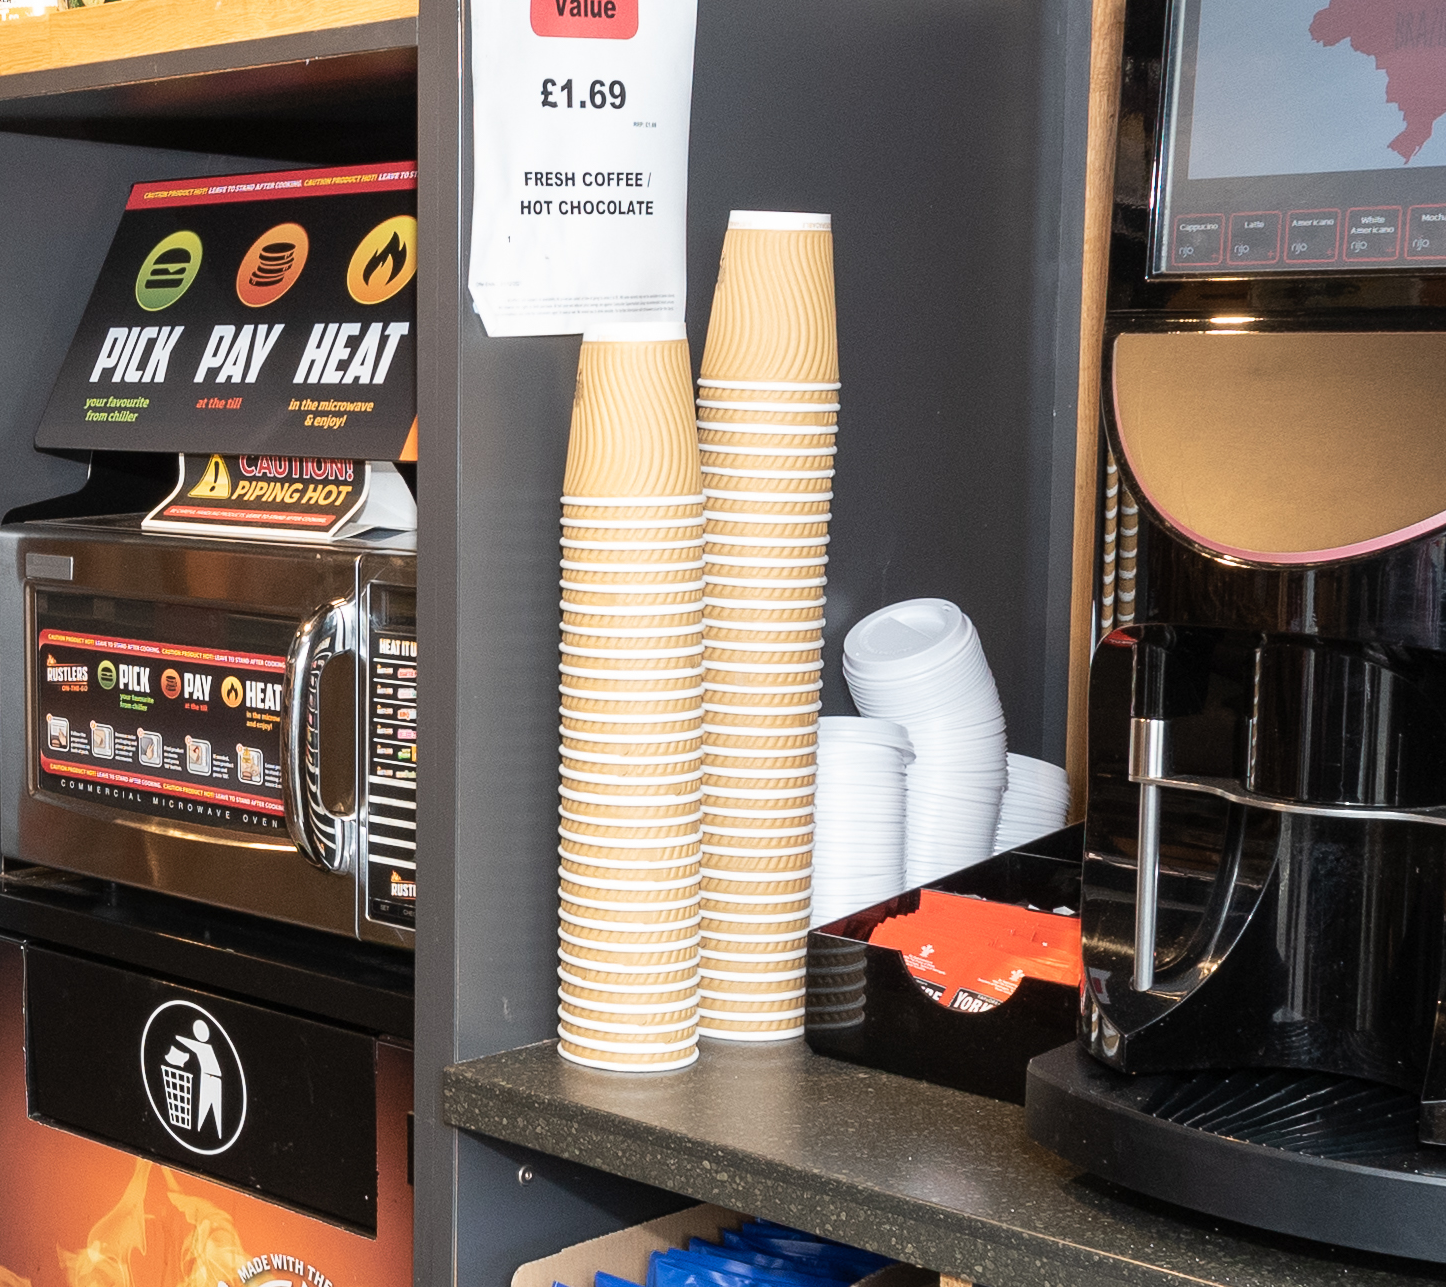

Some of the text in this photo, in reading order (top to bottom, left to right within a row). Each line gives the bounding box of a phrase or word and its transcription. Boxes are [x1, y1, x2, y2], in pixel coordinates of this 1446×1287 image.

[540, 77, 627, 110] £1.69
[524, 170, 644, 188] FRESH COFFEE
[519, 199, 655, 217] HOT CHOCOLATE
[88, 321, 410, 385] PICK PAY HEAT
[84, 396, 150, 410] your favourite
[195, 397, 242, 410] at the till
[288, 398, 374, 413] in the microwave
[85, 410, 138, 423] from chiller
[304, 414, 347, 430] & enjoy!
[238, 455, 355, 482] CAUTION!
[230, 480, 353, 507] PIPING HOT
[46, 663, 282, 712] RUSTLERS PICK PAY HEAT
[59, 777, 144, 803] COMMERCIAL
[151, 795, 232, 821] MICROWAVE
[241, 812, 281, 830] OVEN
[236, 1254, 271, 1284] MADE
[269, 1252, 305, 1276] WITH
